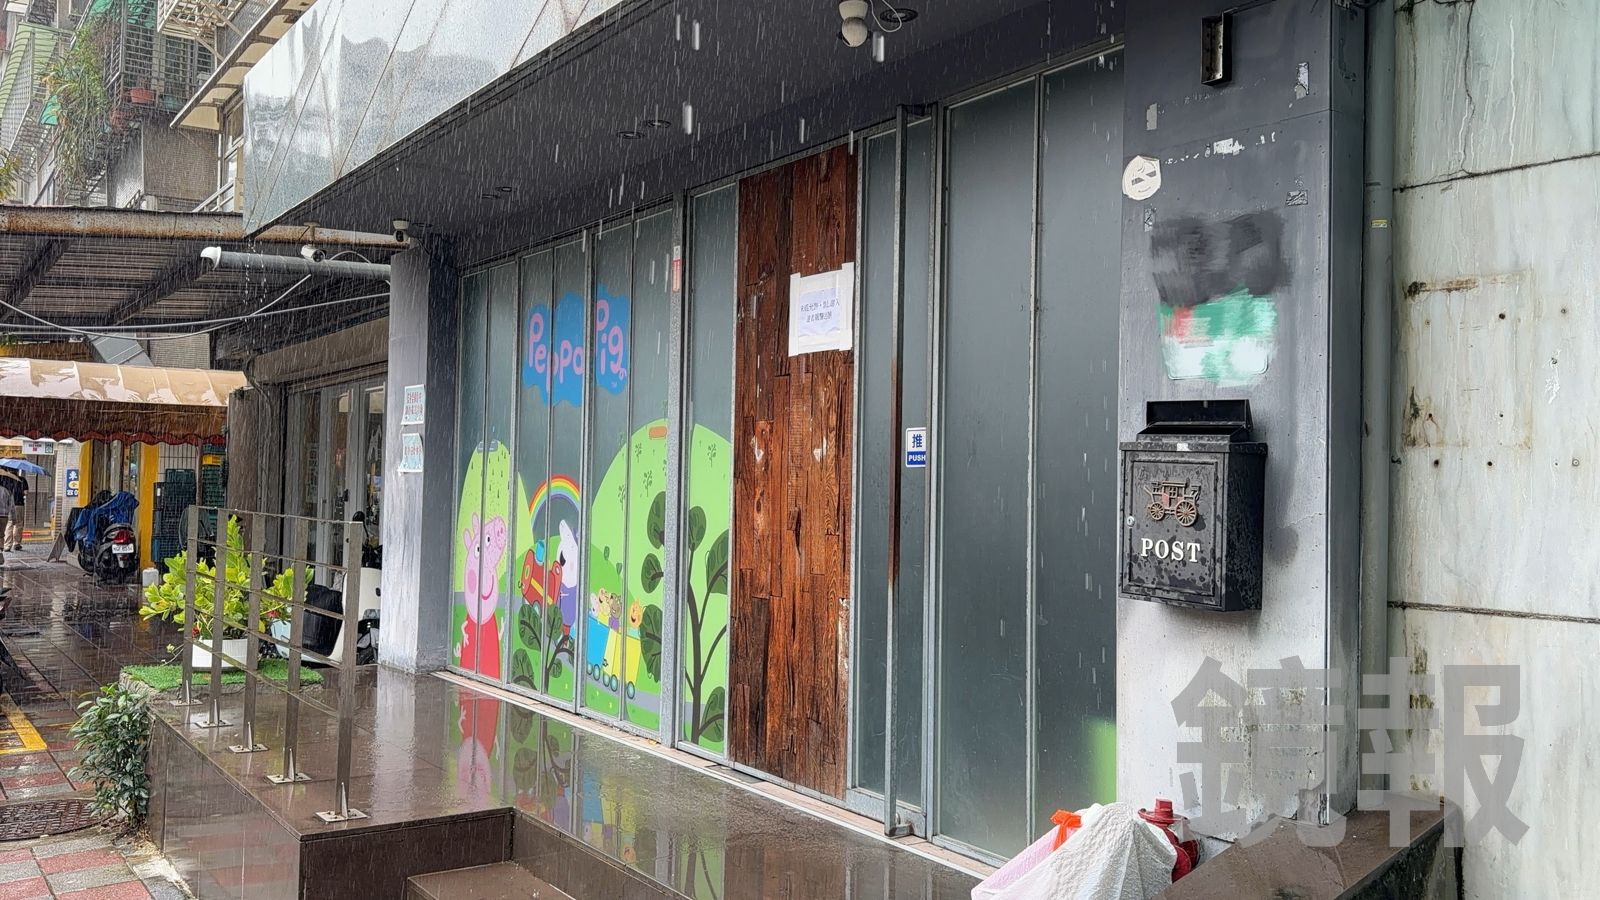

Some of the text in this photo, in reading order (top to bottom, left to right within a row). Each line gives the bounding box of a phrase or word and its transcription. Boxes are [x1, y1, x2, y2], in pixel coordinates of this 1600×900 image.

[528, 299, 627, 393] Peppa Pig
[912, 434, 923, 448] 推
[1141, 537, 1200, 563] POST
